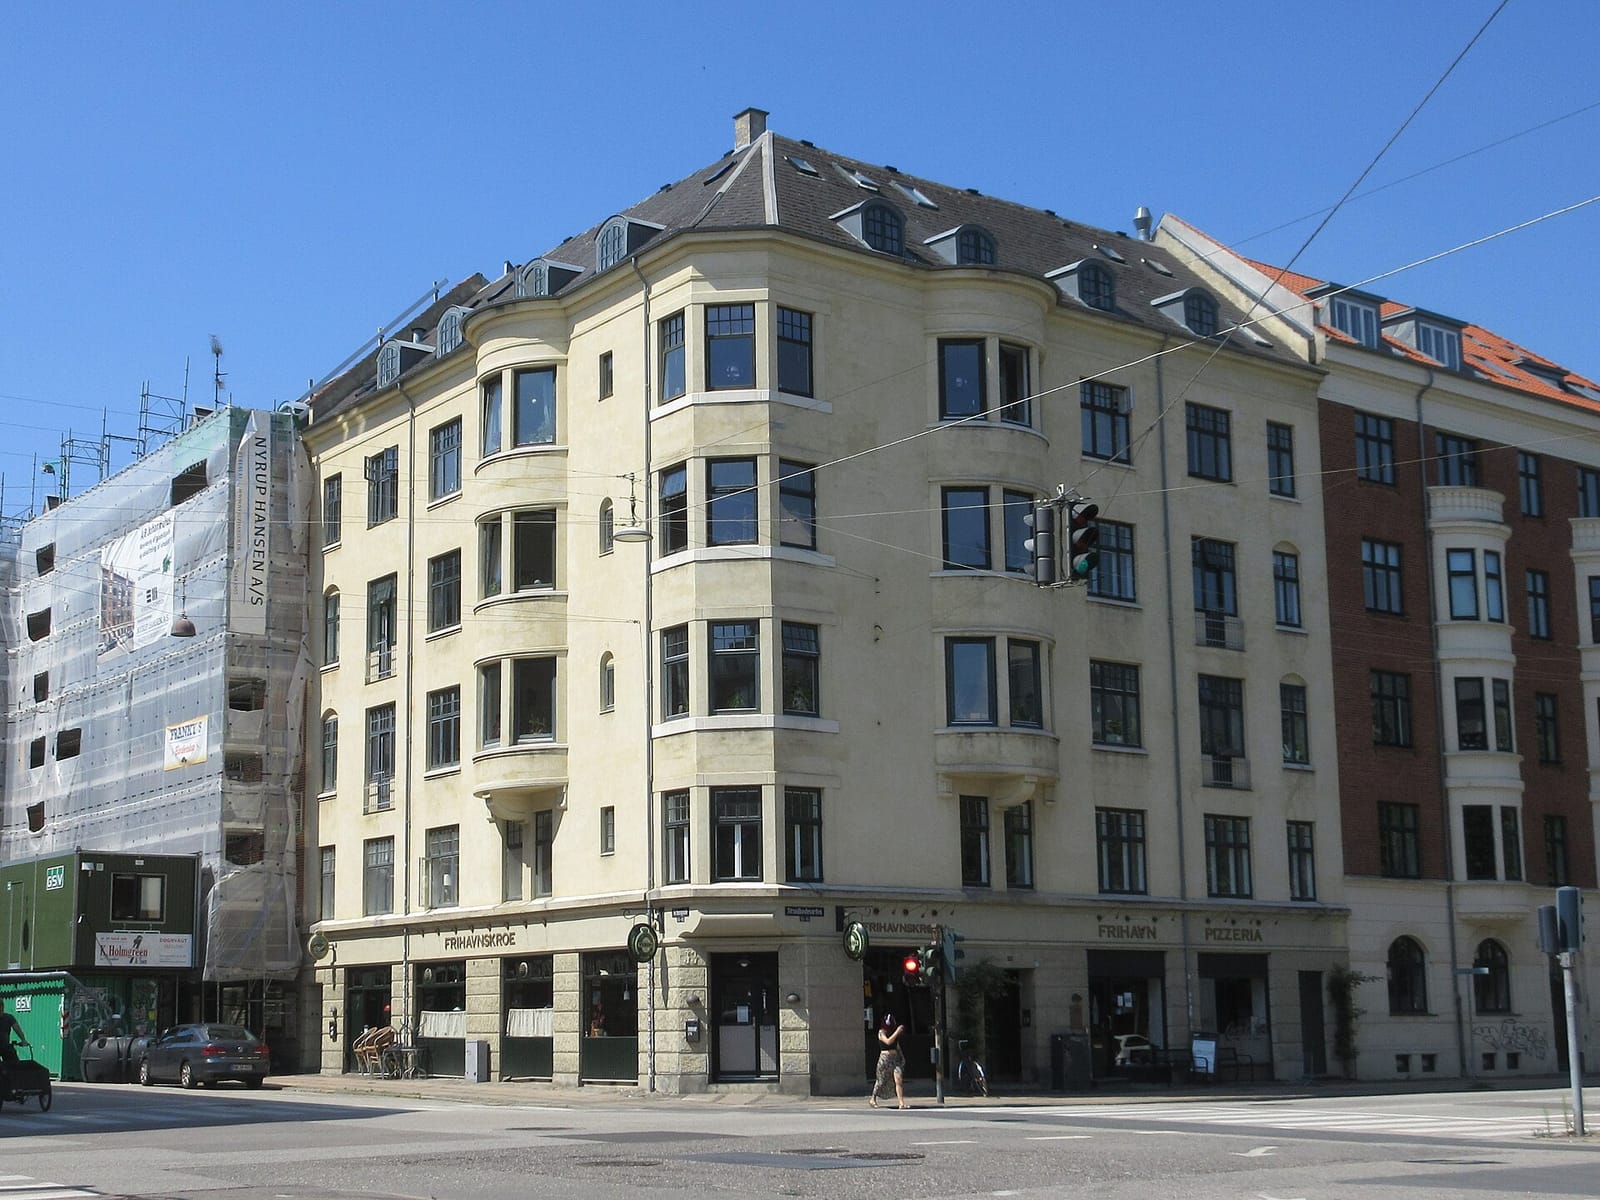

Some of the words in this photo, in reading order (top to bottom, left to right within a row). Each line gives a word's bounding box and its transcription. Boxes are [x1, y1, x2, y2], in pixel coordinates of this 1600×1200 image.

[255, 436, 268, 496] NYRUP
[252, 500, 267, 572] HANSEN
[249, 576, 265, 606] A/S
[47, 874, 64, 888] GSV
[444, 931, 516, 951] FRIHAVNSKROE
[1098, 924, 1157, 940] FRIHAVN
[1204, 927, 1263, 942] PIZZERIA
[108, 944, 148, 959] Holmgreen
[16, 995, 32, 1009] GSV
